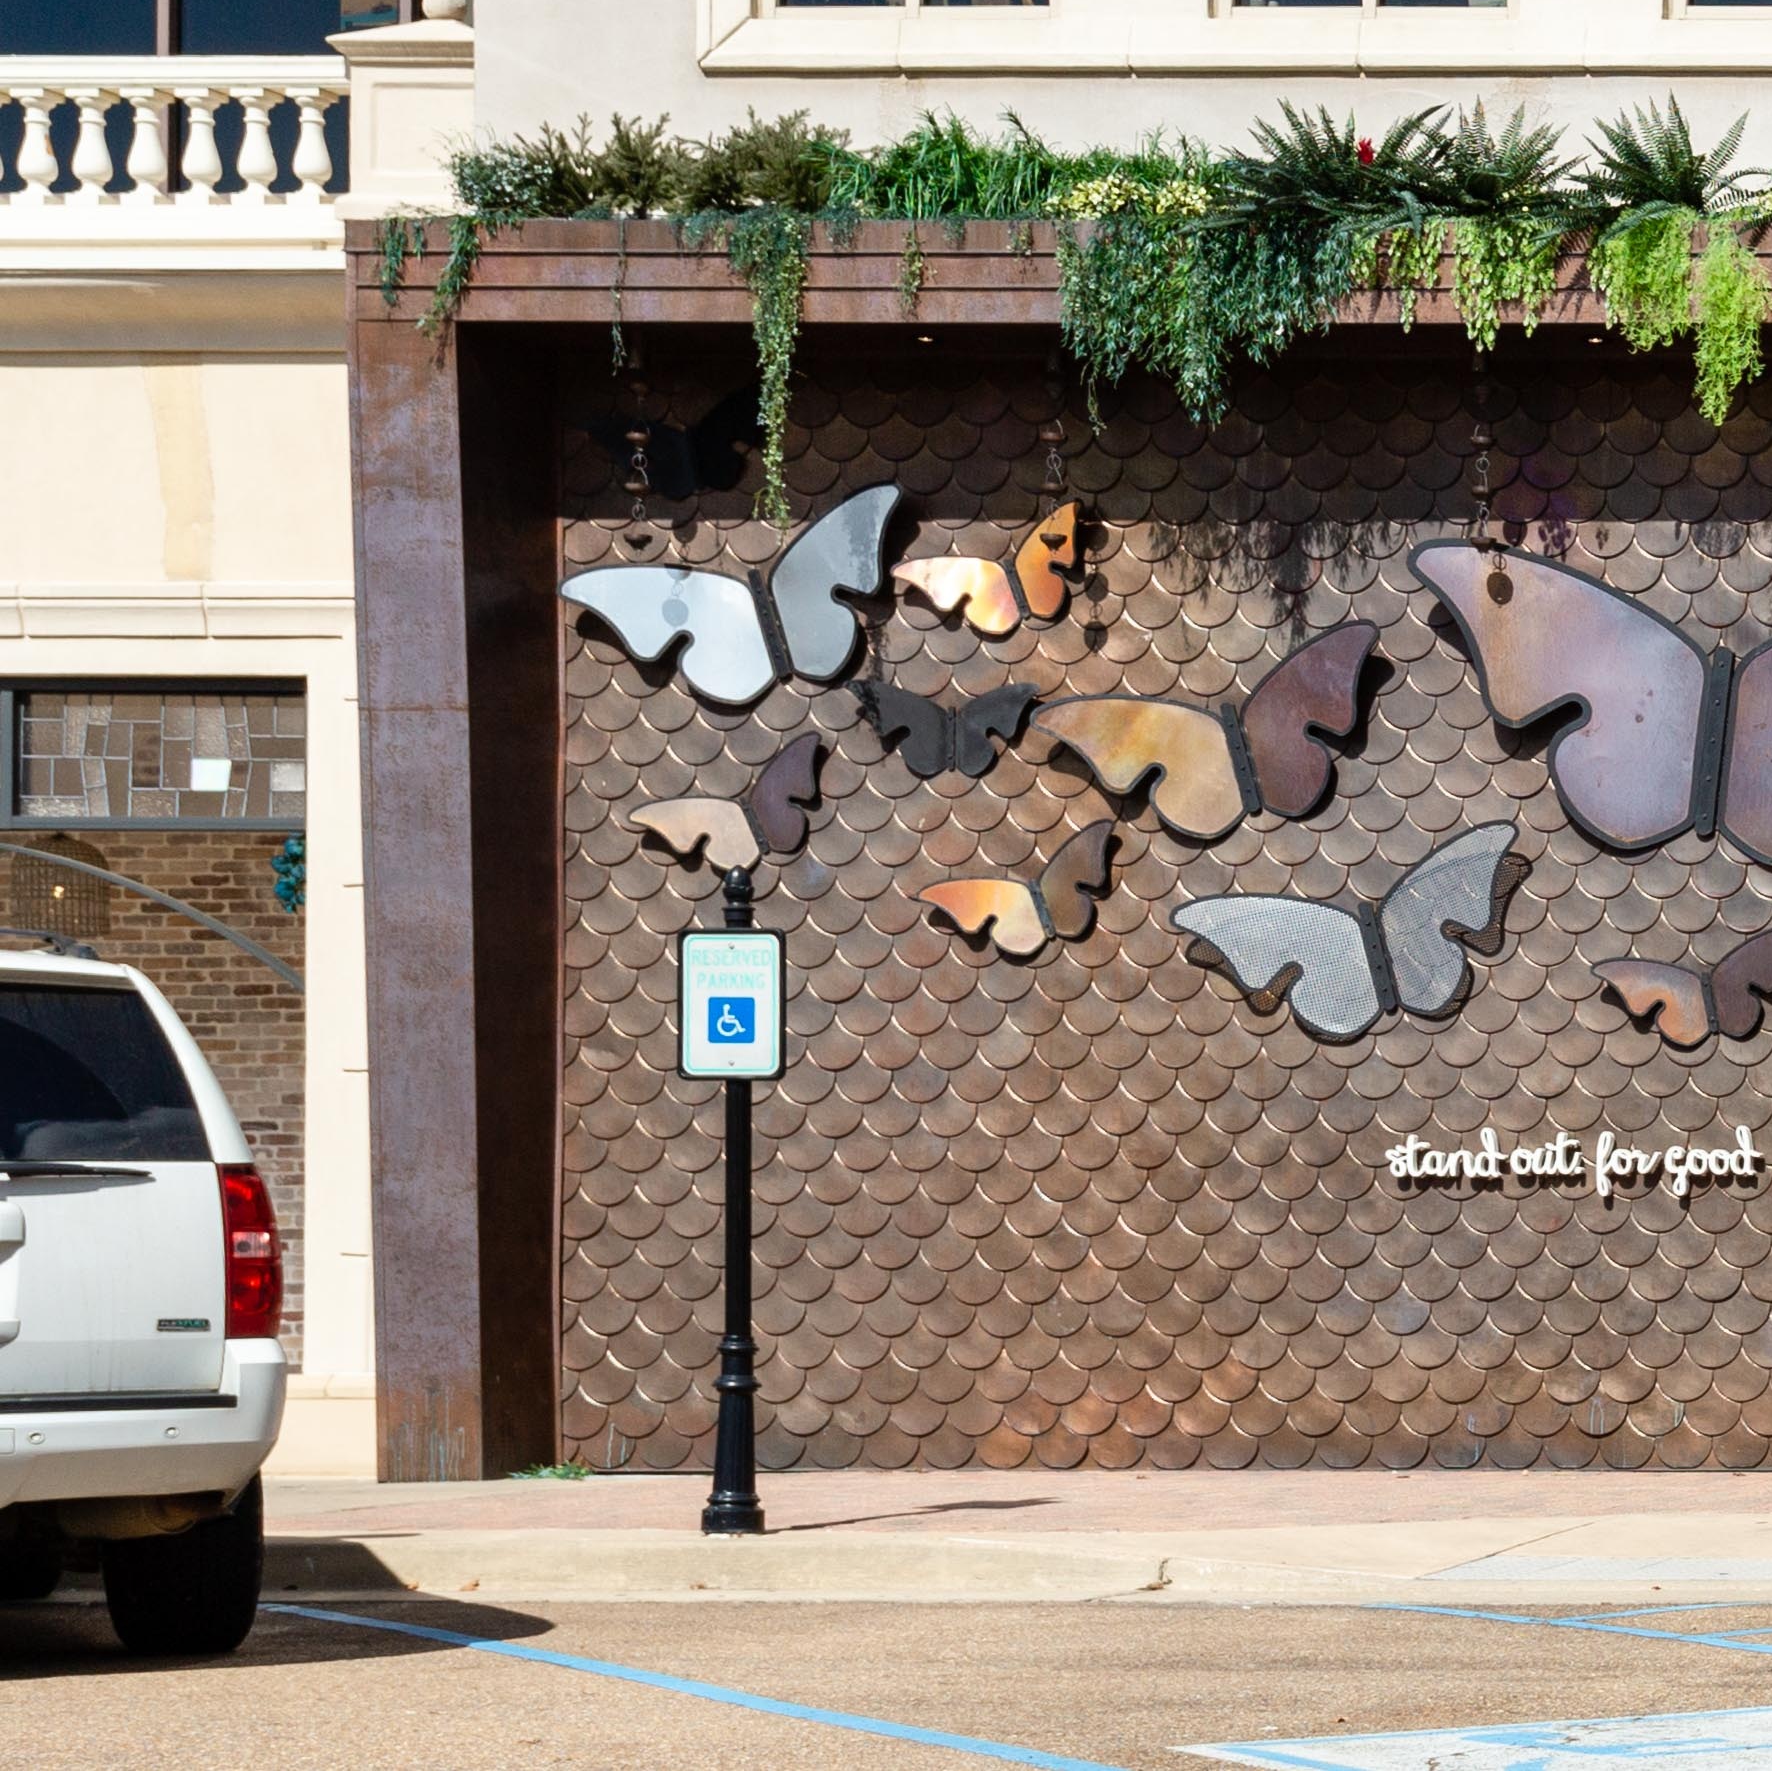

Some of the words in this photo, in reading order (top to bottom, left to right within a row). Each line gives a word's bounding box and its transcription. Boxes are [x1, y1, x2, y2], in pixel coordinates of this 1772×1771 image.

[691, 948, 771, 967] RESERVED
[696, 973, 767, 990] PARKING
[1385, 1126, 1507, 1180] stand
[1595, 1130, 1663, 1197] for
[1663, 1125, 1765, 1197] good
